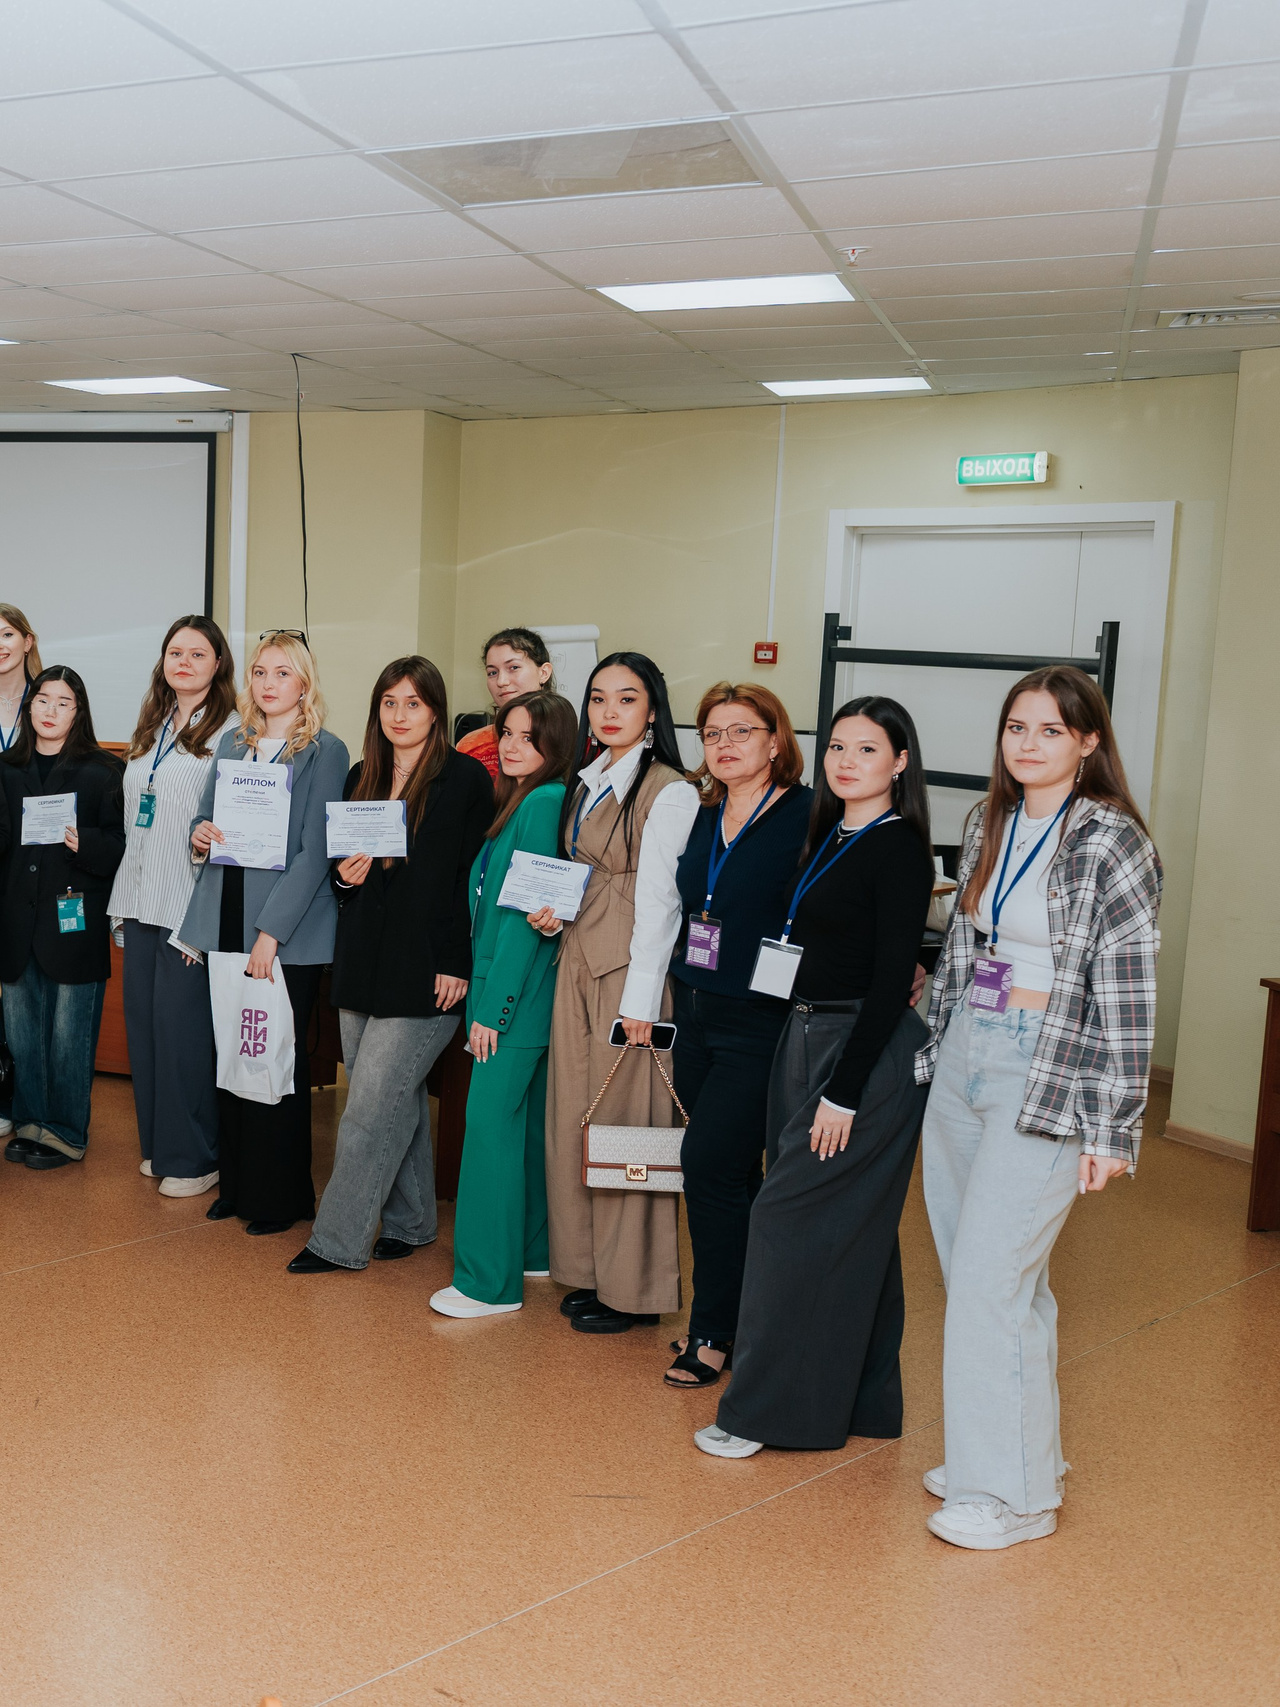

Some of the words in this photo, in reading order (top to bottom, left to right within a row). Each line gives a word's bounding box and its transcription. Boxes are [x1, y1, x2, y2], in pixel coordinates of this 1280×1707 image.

[962, 458, 1031, 477] ВЫХОД
[232, 777, 276, 788] ДИПЛОМ
[531, 859, 571, 872] СЕРТИФИКАТ
[241, 1008, 268, 1025] ЯР
[240, 1024, 268, 1043] ПИ
[239, 1040, 267, 1058] АР
[629, 1168, 644, 1176] MK
